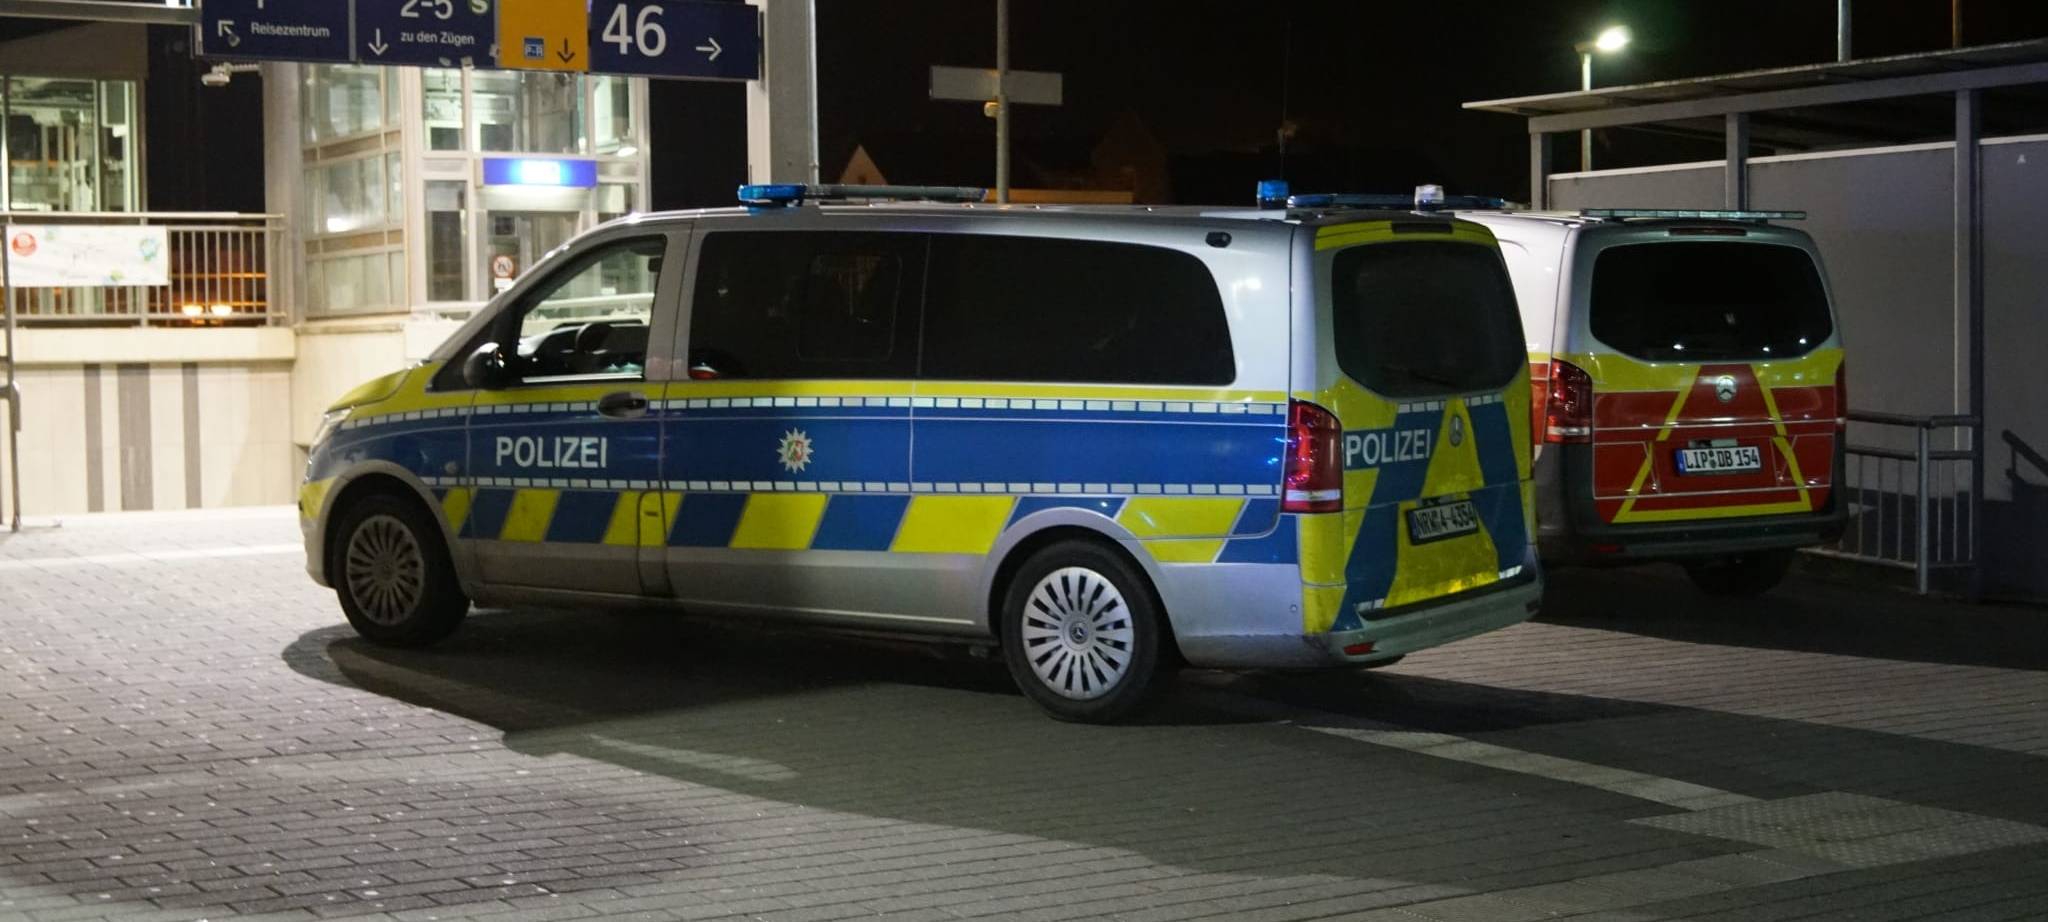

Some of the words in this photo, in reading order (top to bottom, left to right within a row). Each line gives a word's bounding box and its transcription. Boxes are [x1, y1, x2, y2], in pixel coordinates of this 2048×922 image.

[400, 0, 454, 20] 2-5
[250, 21, 331, 38] Reisezentrum
[400, 31, 415, 42] zu
[416, 30, 439, 43] den
[440, 31, 476, 47] Zügen
[601, 3, 668, 57] 46
[496, 436, 607, 468] POLIZEI
[1345, 429, 1431, 467] POLIZEI
[1685, 450, 1708, 469] LIP
[1717, 450, 1733, 468] DB
[1735, 448, 1758, 467] 154
